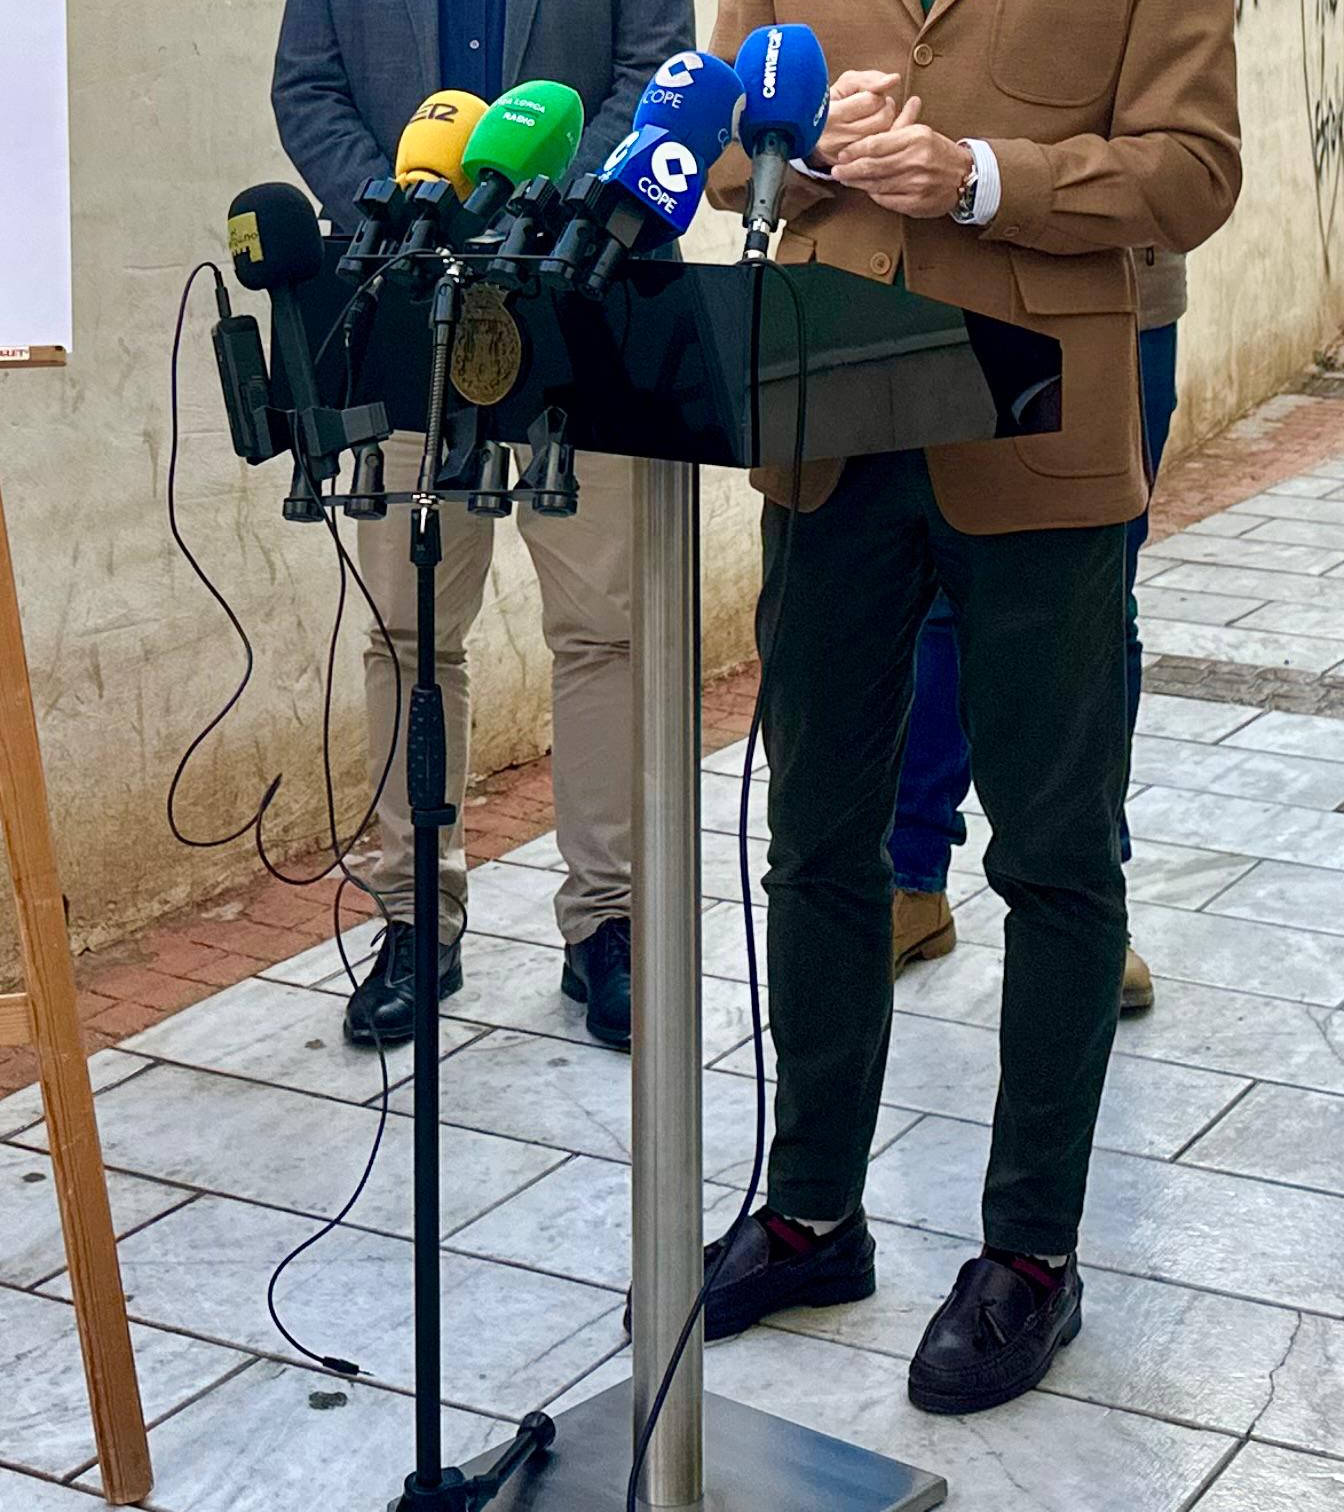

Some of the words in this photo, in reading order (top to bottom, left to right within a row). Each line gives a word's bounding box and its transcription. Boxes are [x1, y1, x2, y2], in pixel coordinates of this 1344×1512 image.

[642, 89, 685, 110] COPE
[502, 111, 536, 127] RADIO
[638, 177, 679, 215] COPE
